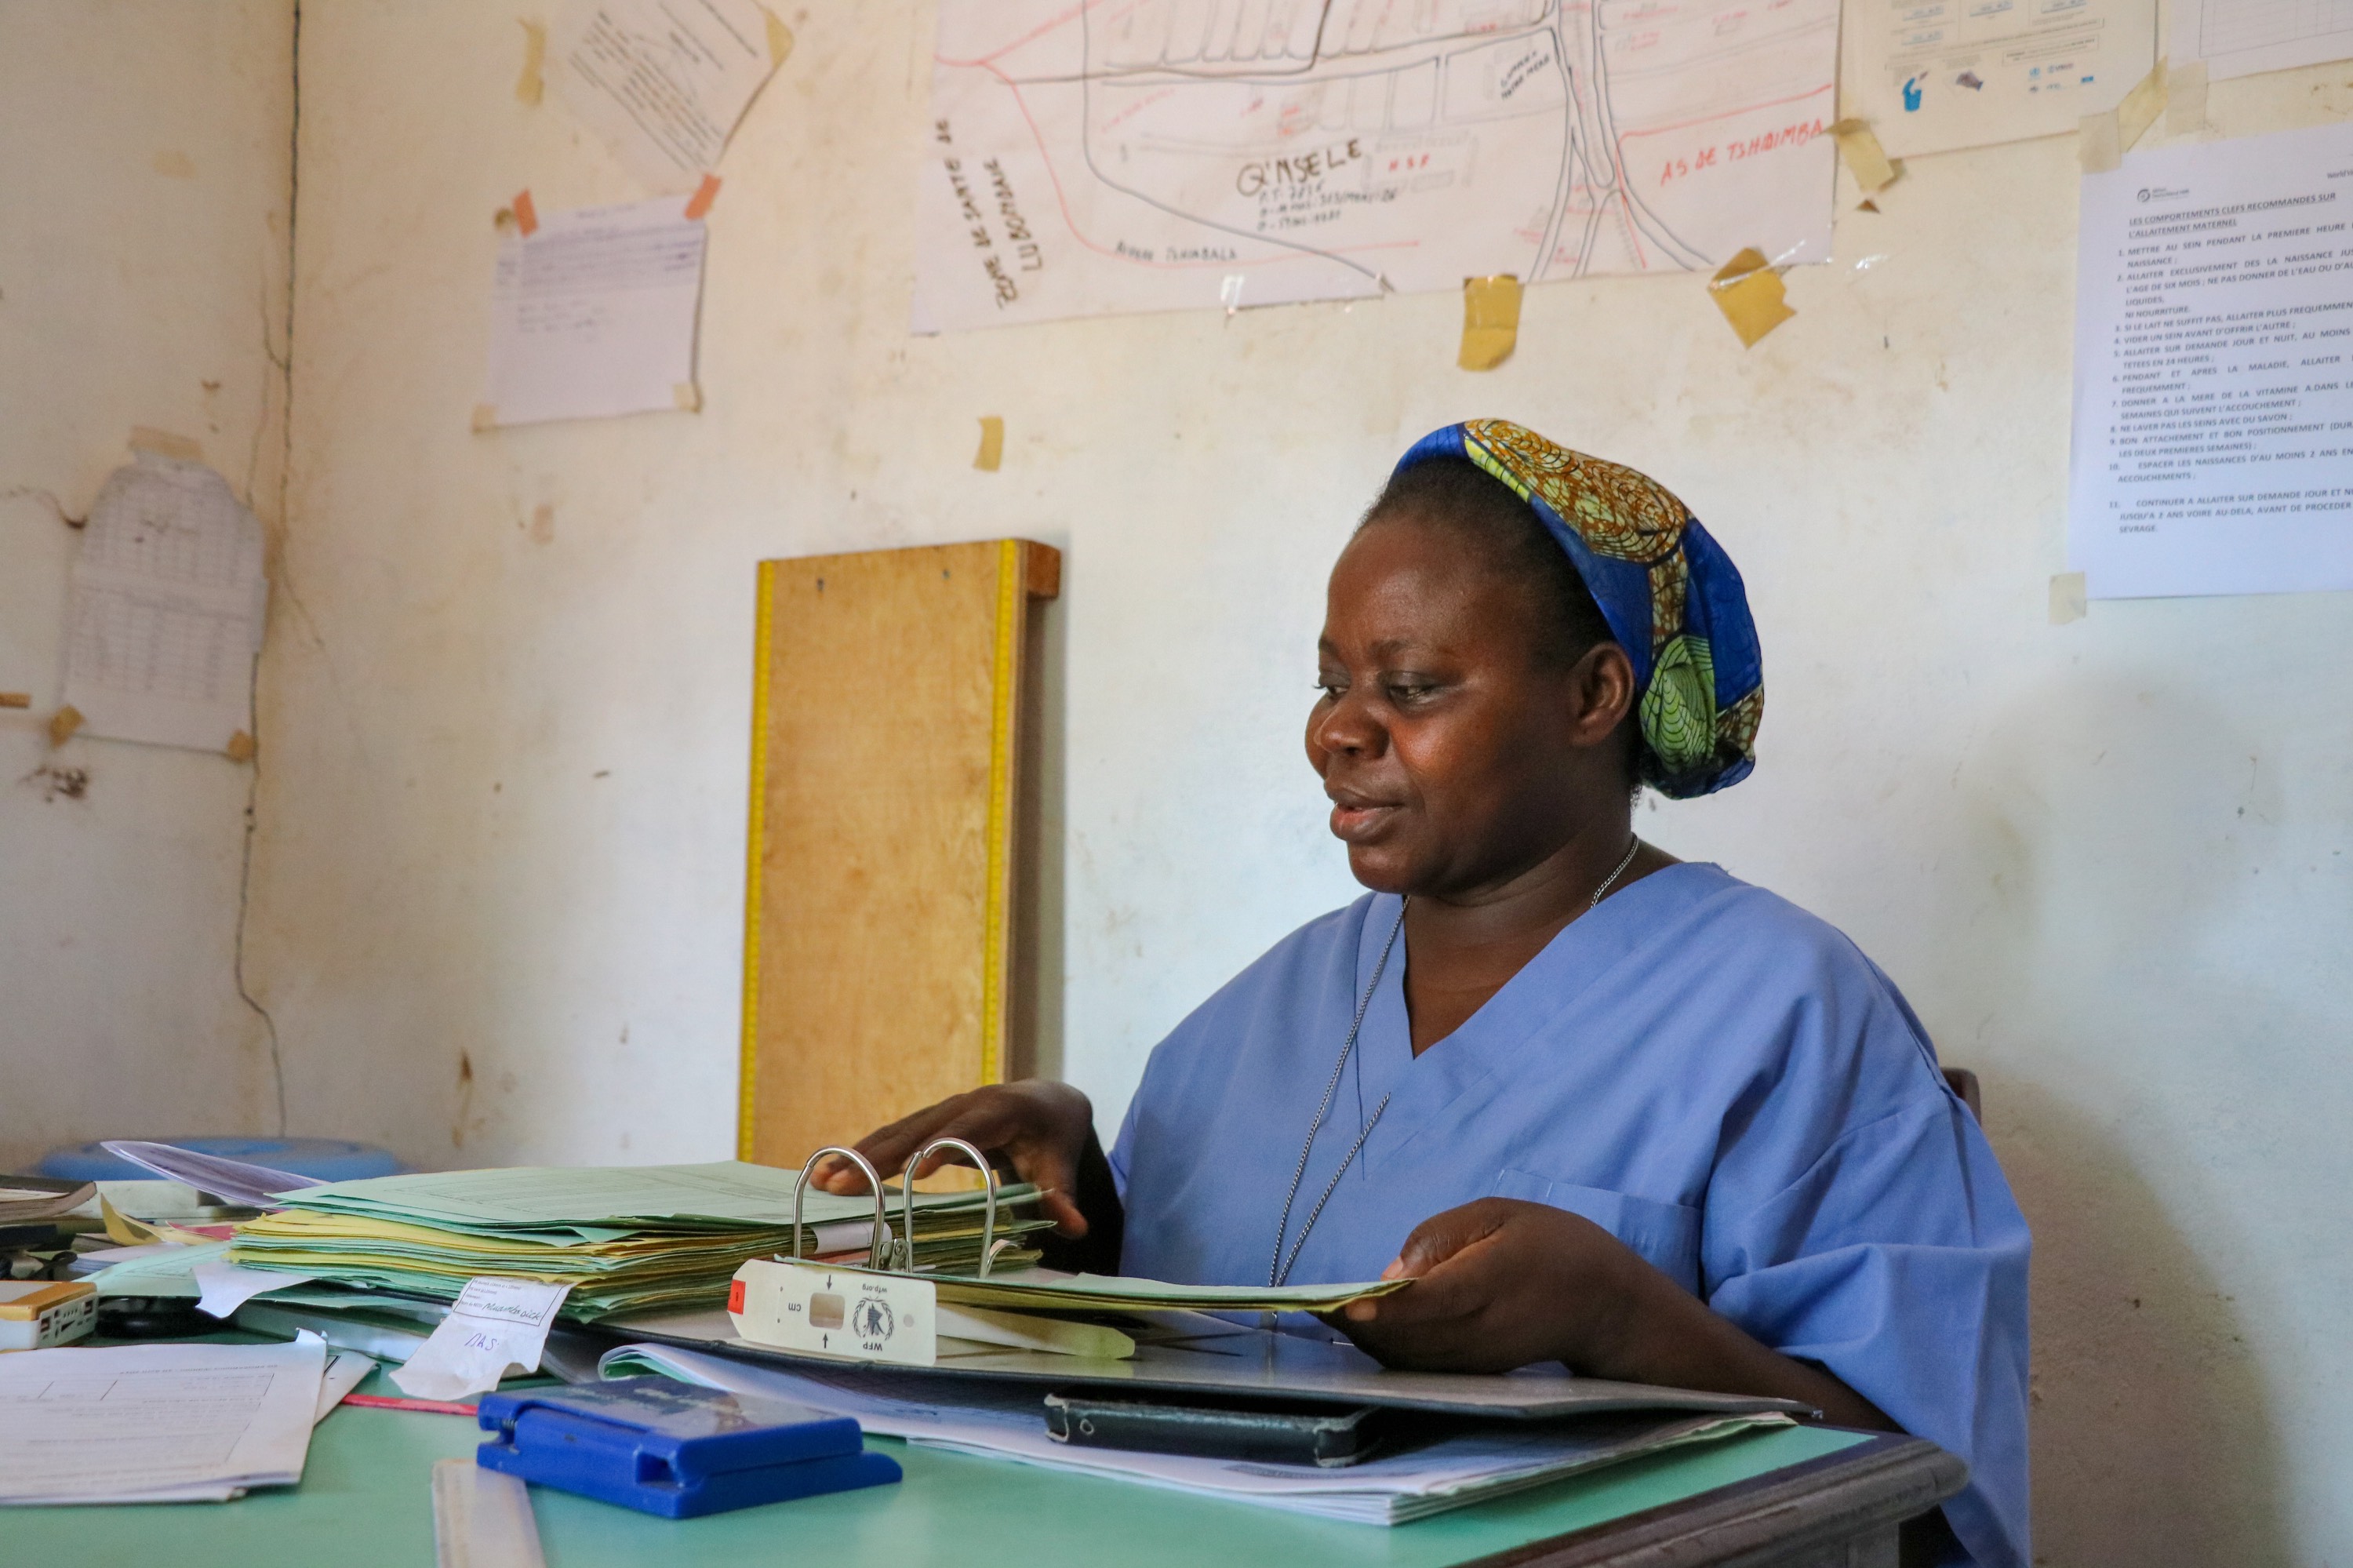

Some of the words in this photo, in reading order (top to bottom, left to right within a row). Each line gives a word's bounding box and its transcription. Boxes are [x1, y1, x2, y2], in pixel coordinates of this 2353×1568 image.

[2129, 217, 2143, 227] LES
[2144, 207, 2220, 224] COMPORTEMENTS
[2221, 204, 2245, 215] CLEFS
[2246, 195, 2316, 212] RECOMMANDES
[2317, 192, 2337, 202] SUR
[2127, 245, 2161, 256] METTRE
[2165, 243, 2178, 252] AU
[2182, 240, 2202, 249] SEIN
[2206, 235, 2246, 246] PENDANT
[2251, 233, 2263, 242] LA
[2267, 227, 2311, 239] PREMIERE
[2315, 223, 2346, 234] HEURE
[2129, 224, 2191, 239] L'ALLAITEMENT
[2193, 219, 2238, 231] MATERNEL
[2127, 270, 2164, 282] ALLAITER
[2169, 262, 2238, 277] EXCLUSIVEMENT
[2245, 259, 2260, 268] DES
[2267, 257, 2278, 266] LA
[2284, 251, 2333, 264] NAISSANCE
[2126, 285, 2148, 294] L'AGE
[2165, 282, 2177, 290] SIX
[2221, 275, 2237, 284] PAS
[2238, 270, 2275, 282] DONNER
[2278, 269, 2289, 278] DE
[2290, 266, 2316, 276] L'EAU
[2317, 264, 2332, 273] OU
[2133, 322, 2144, 331] LE
[2144, 321, 2162, 329] LAIT
[2163, 319, 2175, 328] NE
[2176, 316, 2204, 326] SUFFIT
[2226, 311, 2264, 322] ALLAITER
[2267, 307, 2288, 318] PLUS
[2124, 335, 2148, 344] VIDER
[2151, 333, 2163, 342] UN
[2165, 332, 2184, 340] SEIN
[2184, 329, 2213, 339] AVANT
[2215, 325, 2254, 336] D'OFFRIR
[2256, 321, 2291, 332] L'AUTRE
[2124, 346, 2161, 357] ALLAITER
[2165, 344, 2181, 353] SUR
[2185, 340, 2228, 351] DEMANDE
[2232, 337, 2255, 347] JOUR
[2259, 336, 2269, 344] ET
[2273, 333, 2297, 343] NUIT,
[2320, 328, 2351, 338] MOINS
[2122, 360, 2151, 369] TETEES
[2152, 358, 2164, 367] EN
[2177, 355, 2210, 365] HEURES
[2122, 372, 2161, 382] PENDANT
[2191, 366, 2218, 376] APRES
[2248, 360, 2290, 371] MALADIE,
[2300, 355, 2341, 366] ALLAITER
[2121, 397, 2157, 407] DONNER
[2191, 392, 2215, 402] MERE
[2221, 391, 2232, 399] DE
[2256, 385, 2298, 396] VITAMINE
[2314, 382, 2339, 391] DANS
[2121, 410, 2162, 420] SEMAINES
[2163, 409, 2179, 417] QUI
[2182, 406, 2217, 416] SUIVENT
[2218, 399, 2297, 413] L'ACCOUCHEMENT
[2133, 423, 2159, 432] LAVER
[2177, 420, 2191, 429] LES
[2193, 419, 2217, 427] SEINS
[2218, 417, 2241, 426] AVEC
[2243, 416, 2255, 424] DU
[2257, 414, 2287, 423] SAVON
[2119, 437, 2138, 446] BON
[2141, 432, 2204, 444] ATTACHEMENT
[2223, 430, 2242, 438] BON
[2248, 424, 2325, 437] POSITIONNEMENT
[2133, 449, 2157, 457] DEUX
[2158, 446, 2205, 456] PREMIERES
[2138, 460, 2174, 470] ESPACER
[2195, 455, 2247, 466] NAISSANCES
[2249, 453, 2272, 462] D'AU
[2275, 451, 2306, 460] MOINS
[2318, 449, 2338, 458] ANS
[2137, 497, 2185, 508] CONTINUER
[2196, 495, 2235, 504] ALLAITER
[2237, 493, 2255, 502] SUR
[2257, 491, 2301, 500] DEMANDE
[2304, 489, 2328, 498] JOUR
[2119, 511, 2155, 521] JUSQU'A
[2166, 510, 2184, 518] ANS
[2187, 509, 2212, 518] VOIRE
[2257, 505, 2287, 514] AVANT
[2306, 501, 2352, 511] PROCEDER
[862, 1282, 888, 1293] wfp.org
[787, 1302, 802, 1312] cm
[863, 1341, 882, 1352] WFP
